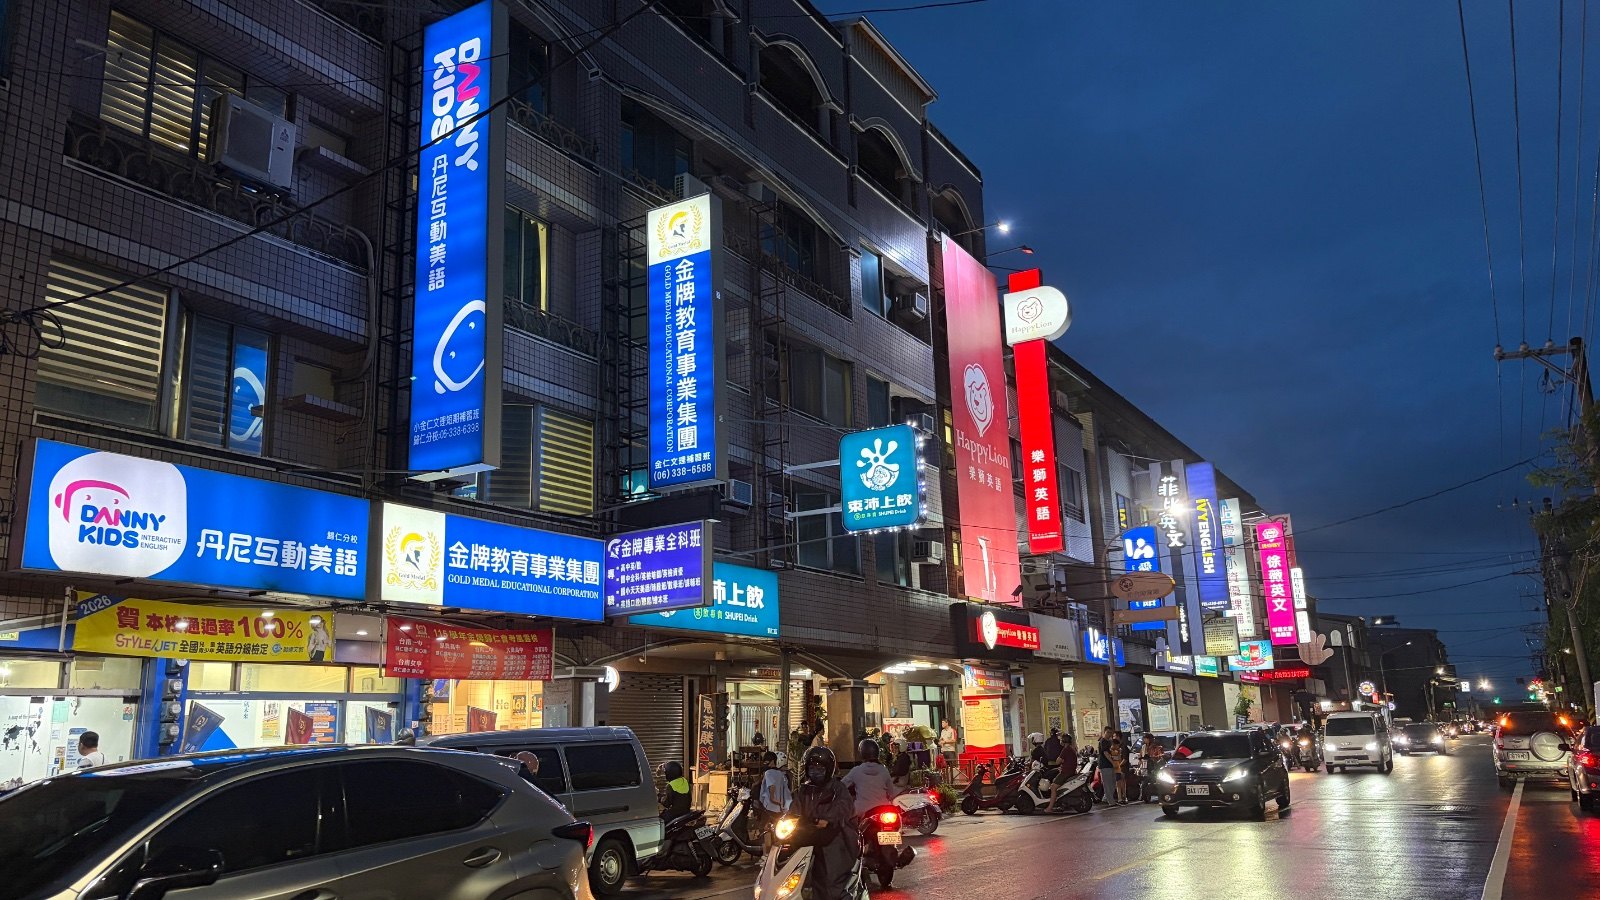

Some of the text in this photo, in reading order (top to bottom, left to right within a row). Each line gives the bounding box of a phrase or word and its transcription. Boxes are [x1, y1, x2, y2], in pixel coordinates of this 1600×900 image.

[431, 47, 456, 145] KIDS
[455, 37, 481, 171] DANNY
[428, 153, 448, 292] 丹尼互動美語
[1011, 320, 1053, 334] HappyLion
[664, 265, 674, 453] GOLD MEDAL EDUCATIONAL CORPORATION
[675, 258, 698, 452] 金牌教育事業集團
[955, 428, 1009, 469] HappyLion
[968, 465, 1002, 492] 樂獅英語
[1031, 449, 1050, 521] 樂獅英語
[80, 504, 166, 532] DANNY
[78, 524, 182, 549] KIDS INTERACTIVE
[140, 541, 168, 551] ENGLISH
[326, 531, 358, 545] 歸仁分校
[621, 529, 701, 559] 金牌專業全科班
[196, 528, 358, 577] 丹尼互動美語
[448, 541, 600, 586] 金牌教育事業集團
[447, 574, 599, 600] GOLD MEDAL EDUCATIONAL CORPORATION
[1266, 555, 1288, 612] 徐薇英文
[80, 595, 112, 615] 2026
[116, 605, 140, 631] 賀
[724, 611, 744, 622] SHUPEI
[744, 613, 758, 623] Drink
